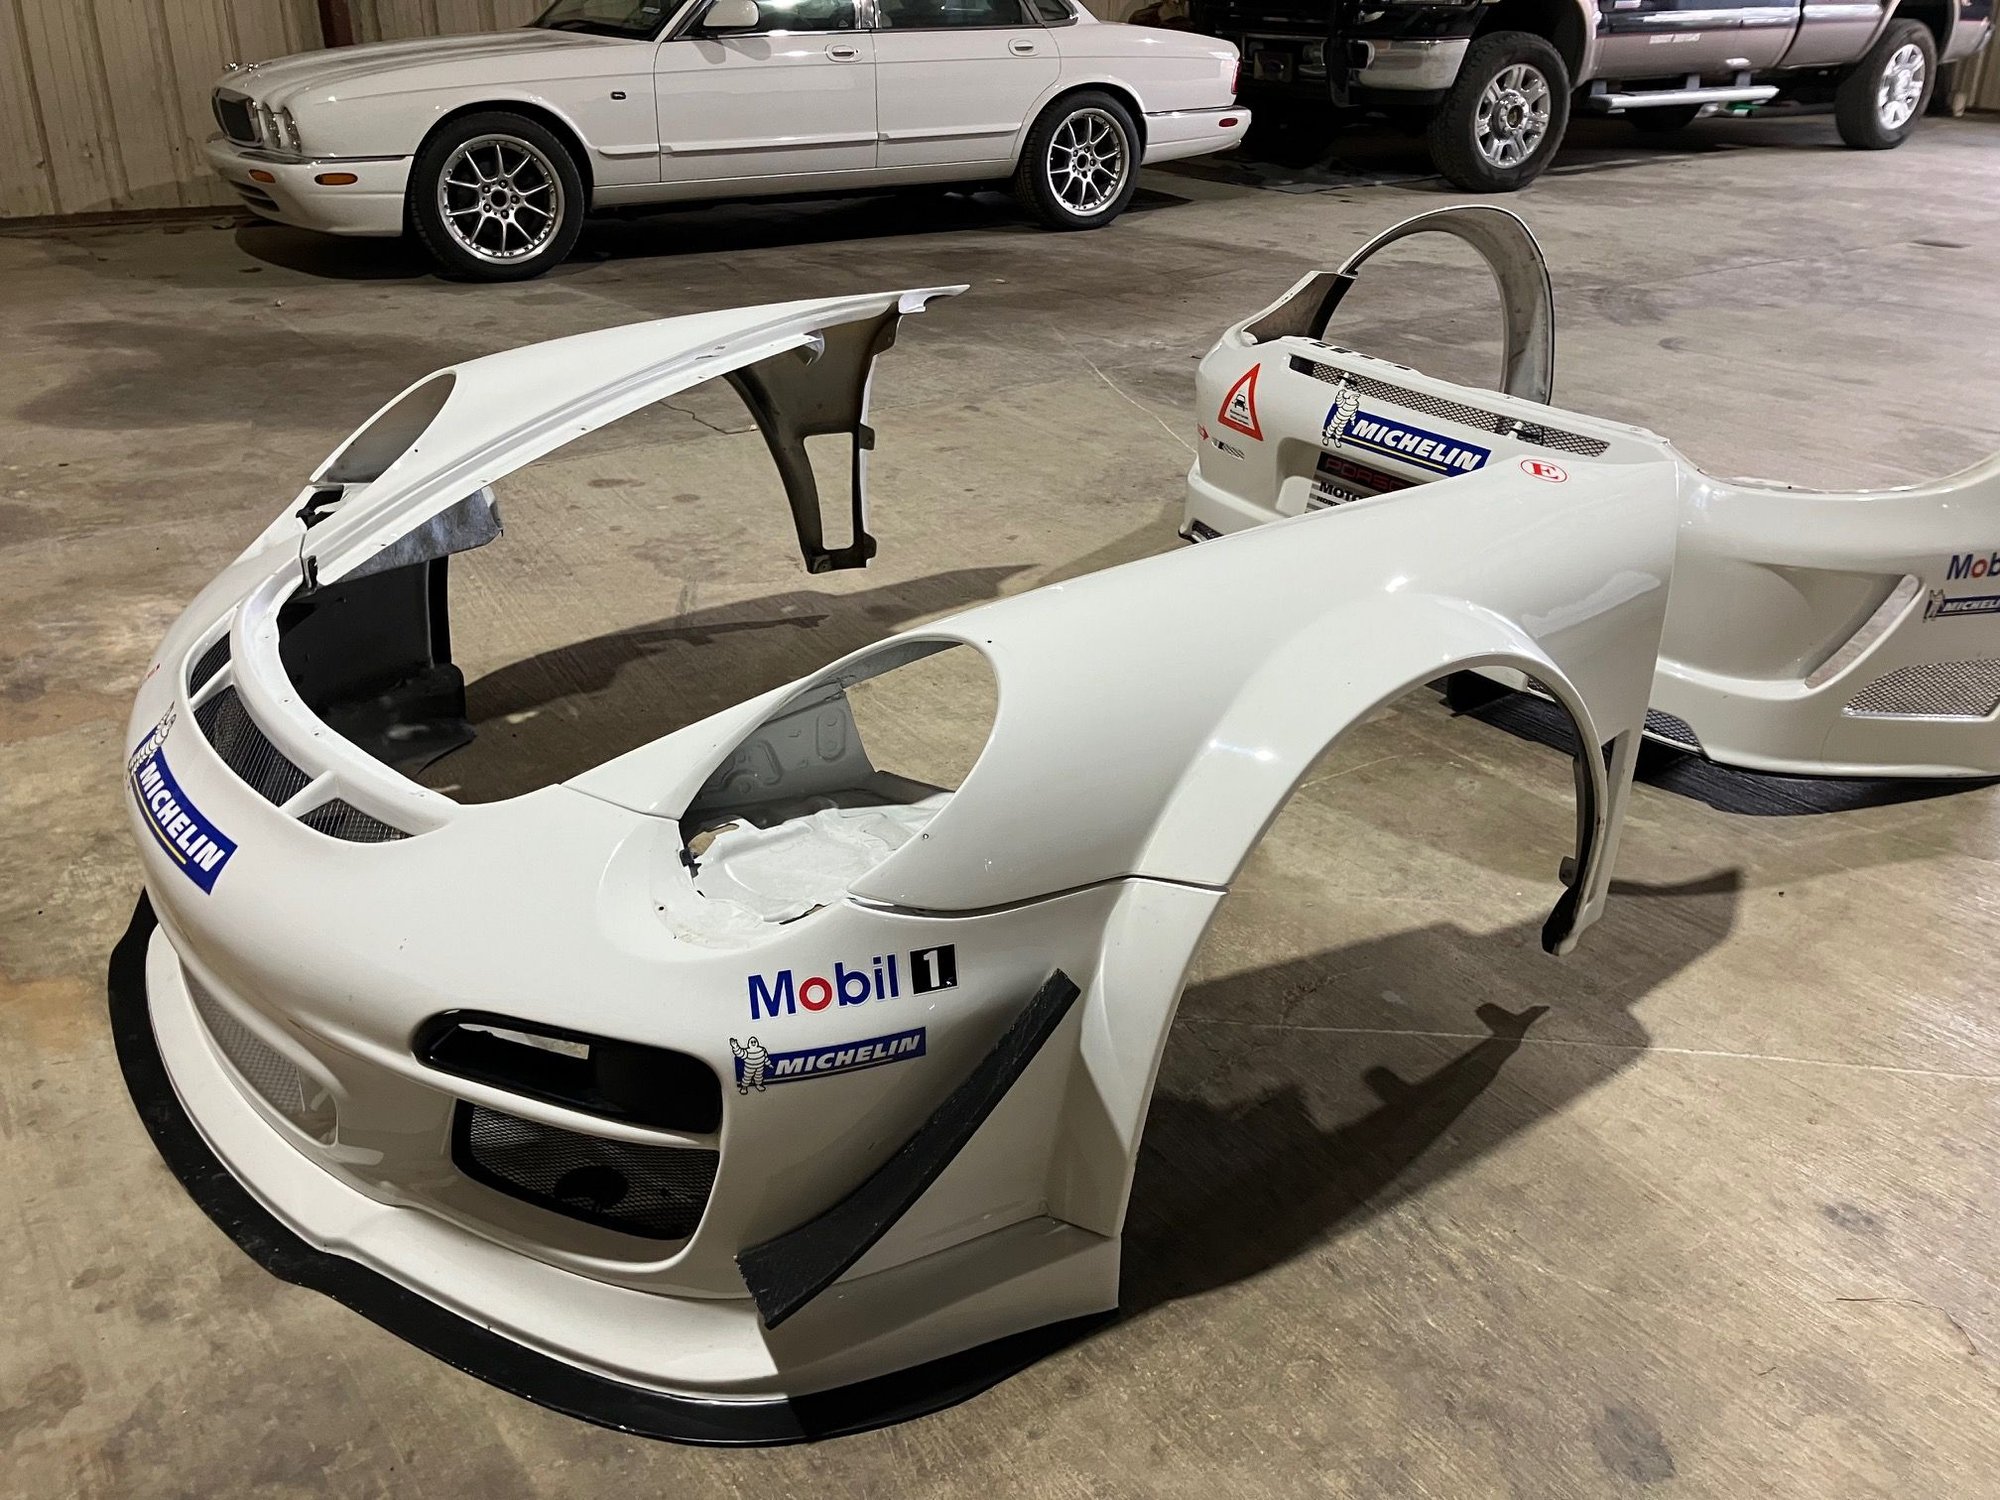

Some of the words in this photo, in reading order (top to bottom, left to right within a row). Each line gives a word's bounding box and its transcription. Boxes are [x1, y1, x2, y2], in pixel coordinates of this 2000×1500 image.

[1352, 419, 1482, 471] MICHELIN
[1531, 462, 1560, 480] E
[139, 763, 226, 872] MICHELIN
[748, 954, 899, 1020] Mobil
[923, 950, 942, 988] 1
[774, 1034, 921, 1076] MICHELIN
